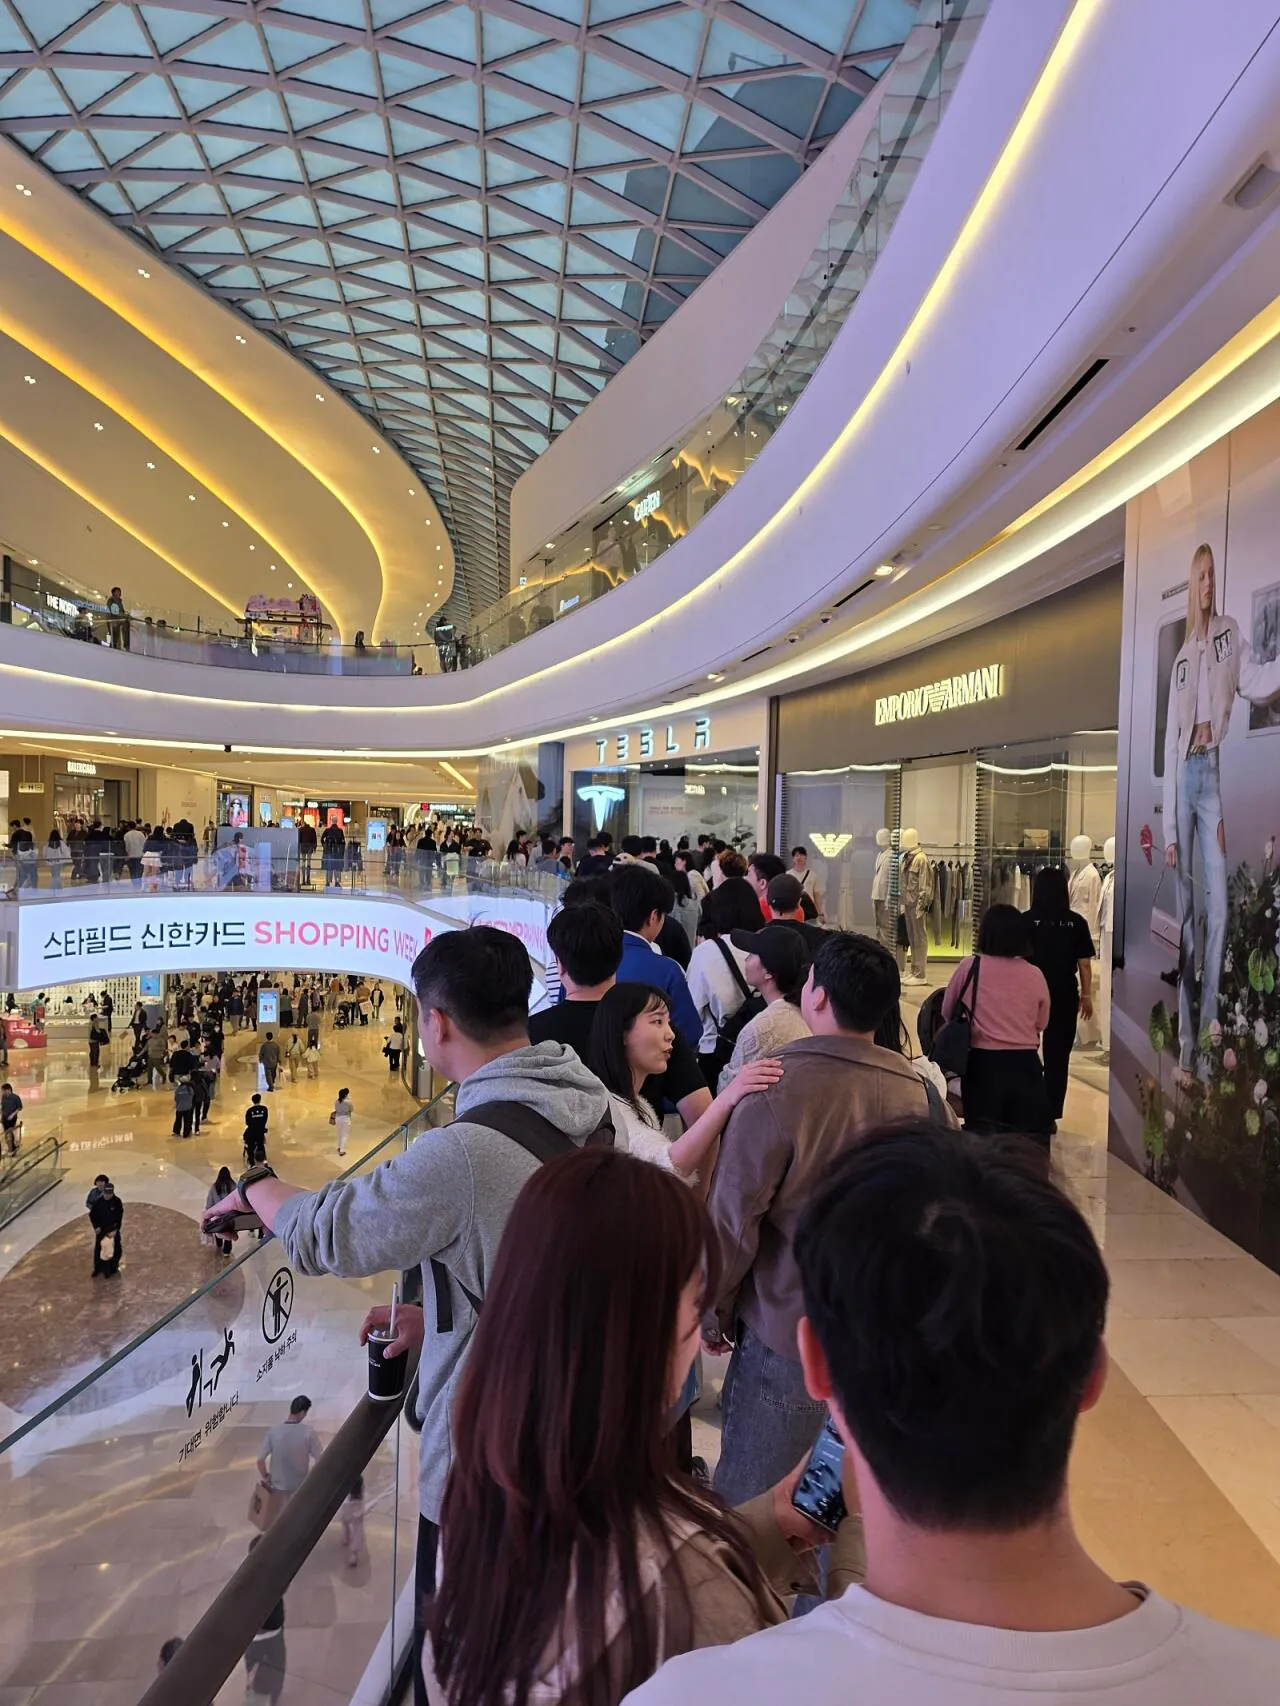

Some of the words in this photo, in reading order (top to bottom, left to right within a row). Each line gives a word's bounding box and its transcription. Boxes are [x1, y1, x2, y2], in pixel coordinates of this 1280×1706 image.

[46, 594, 59, 610] THE
[874, 684, 929, 726] EMPORIO
[942, 663, 1002, 710] ARMANI
[595, 717, 712, 764] TESLA
[43, 924, 132, 960] 스타필드
[140, 921, 246, 950] 신한카드
[254, 920, 389, 953] SHOPPING
[394, 928, 418, 963] WEEK
[1033, 920, 1074, 928] TLA
[256, 1354, 274, 1382] 소지품
[274, 1341, 286, 1361] 낙하
[286, 1329, 297, 1350] 주의
[178, 1429, 202, 1463] 기대면
[205, 1391, 239, 1436] 위험합니다
